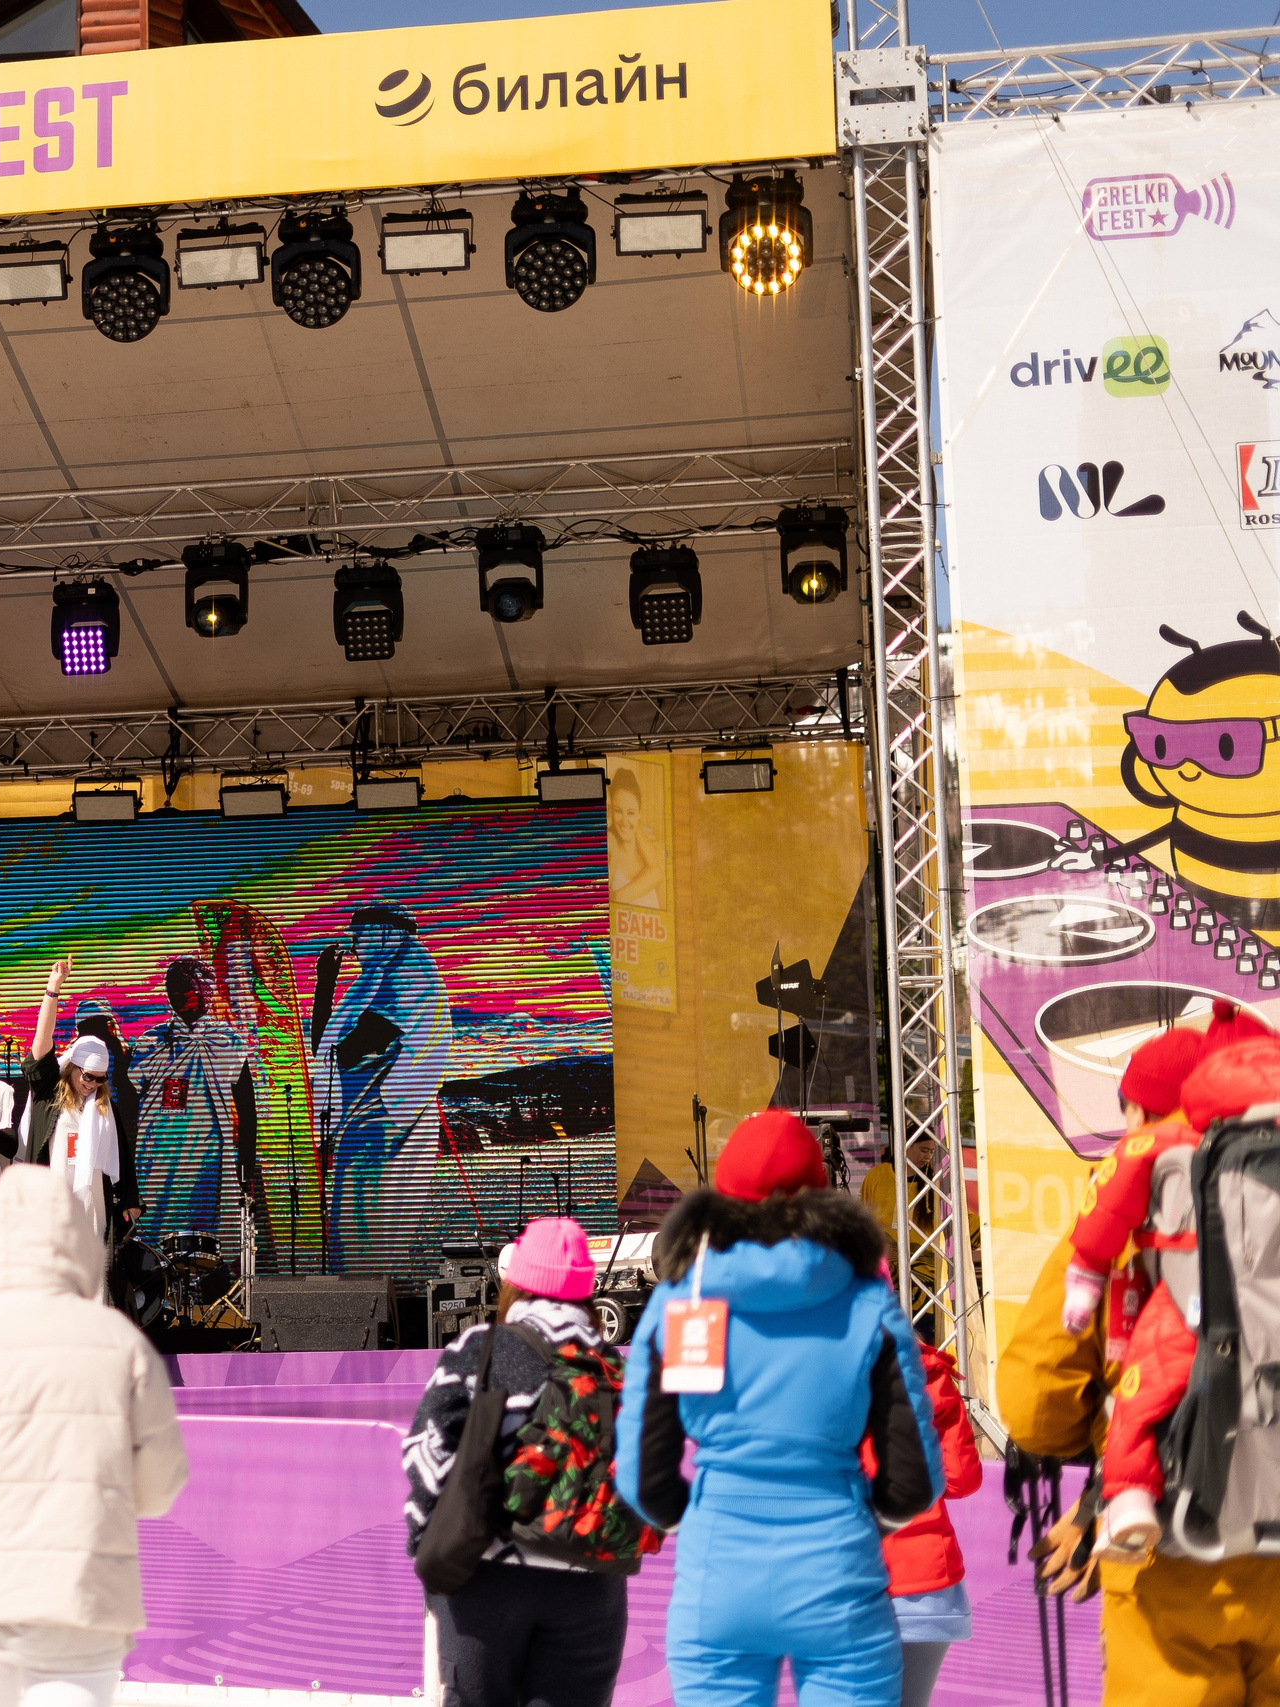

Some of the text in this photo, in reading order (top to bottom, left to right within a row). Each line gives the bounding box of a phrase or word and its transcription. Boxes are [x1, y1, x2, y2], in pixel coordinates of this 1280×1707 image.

[452, 52, 688, 116] билайн
[1096, 182, 1170, 207] GRELKA
[1097, 207, 1148, 231] FEST
[1010, 345, 1171, 388] drivee
[616, 910, 667, 940] БАНЬ
[611, 937, 638, 963] РЕ
